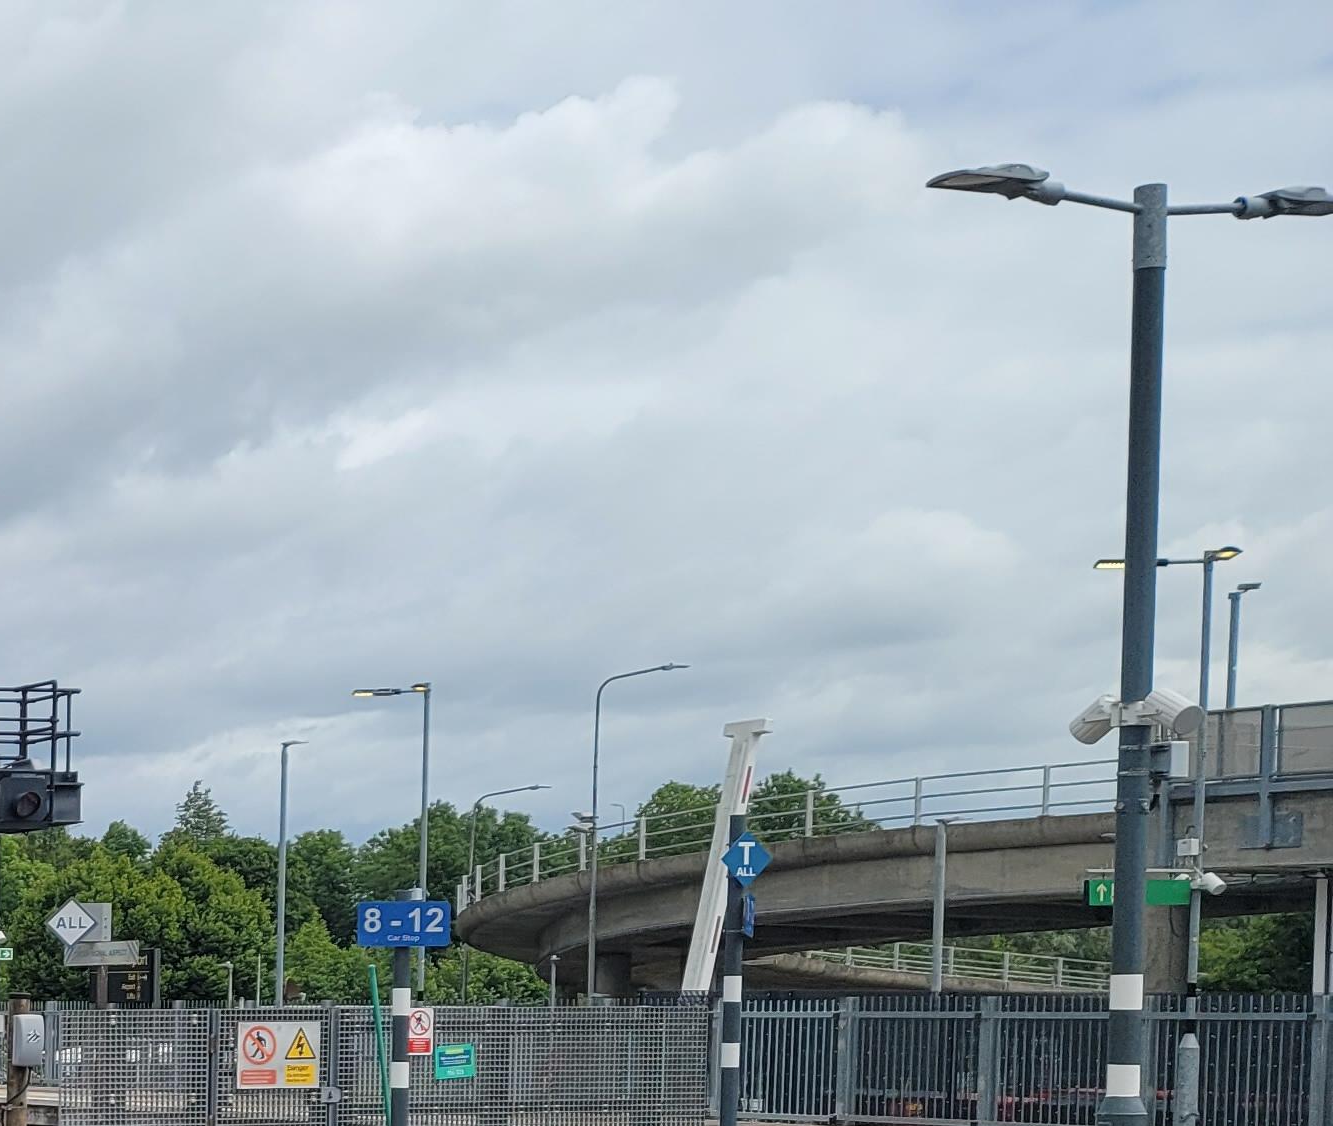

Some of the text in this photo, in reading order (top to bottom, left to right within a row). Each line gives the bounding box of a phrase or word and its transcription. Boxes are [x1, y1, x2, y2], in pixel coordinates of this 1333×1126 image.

[738, 841, 755, 865] T
[735, 867, 757, 876] ALL
[56, 917, 87, 929] ALL
[408, 907, 444, 933] 12
[402, 934, 420, 943] Stop
